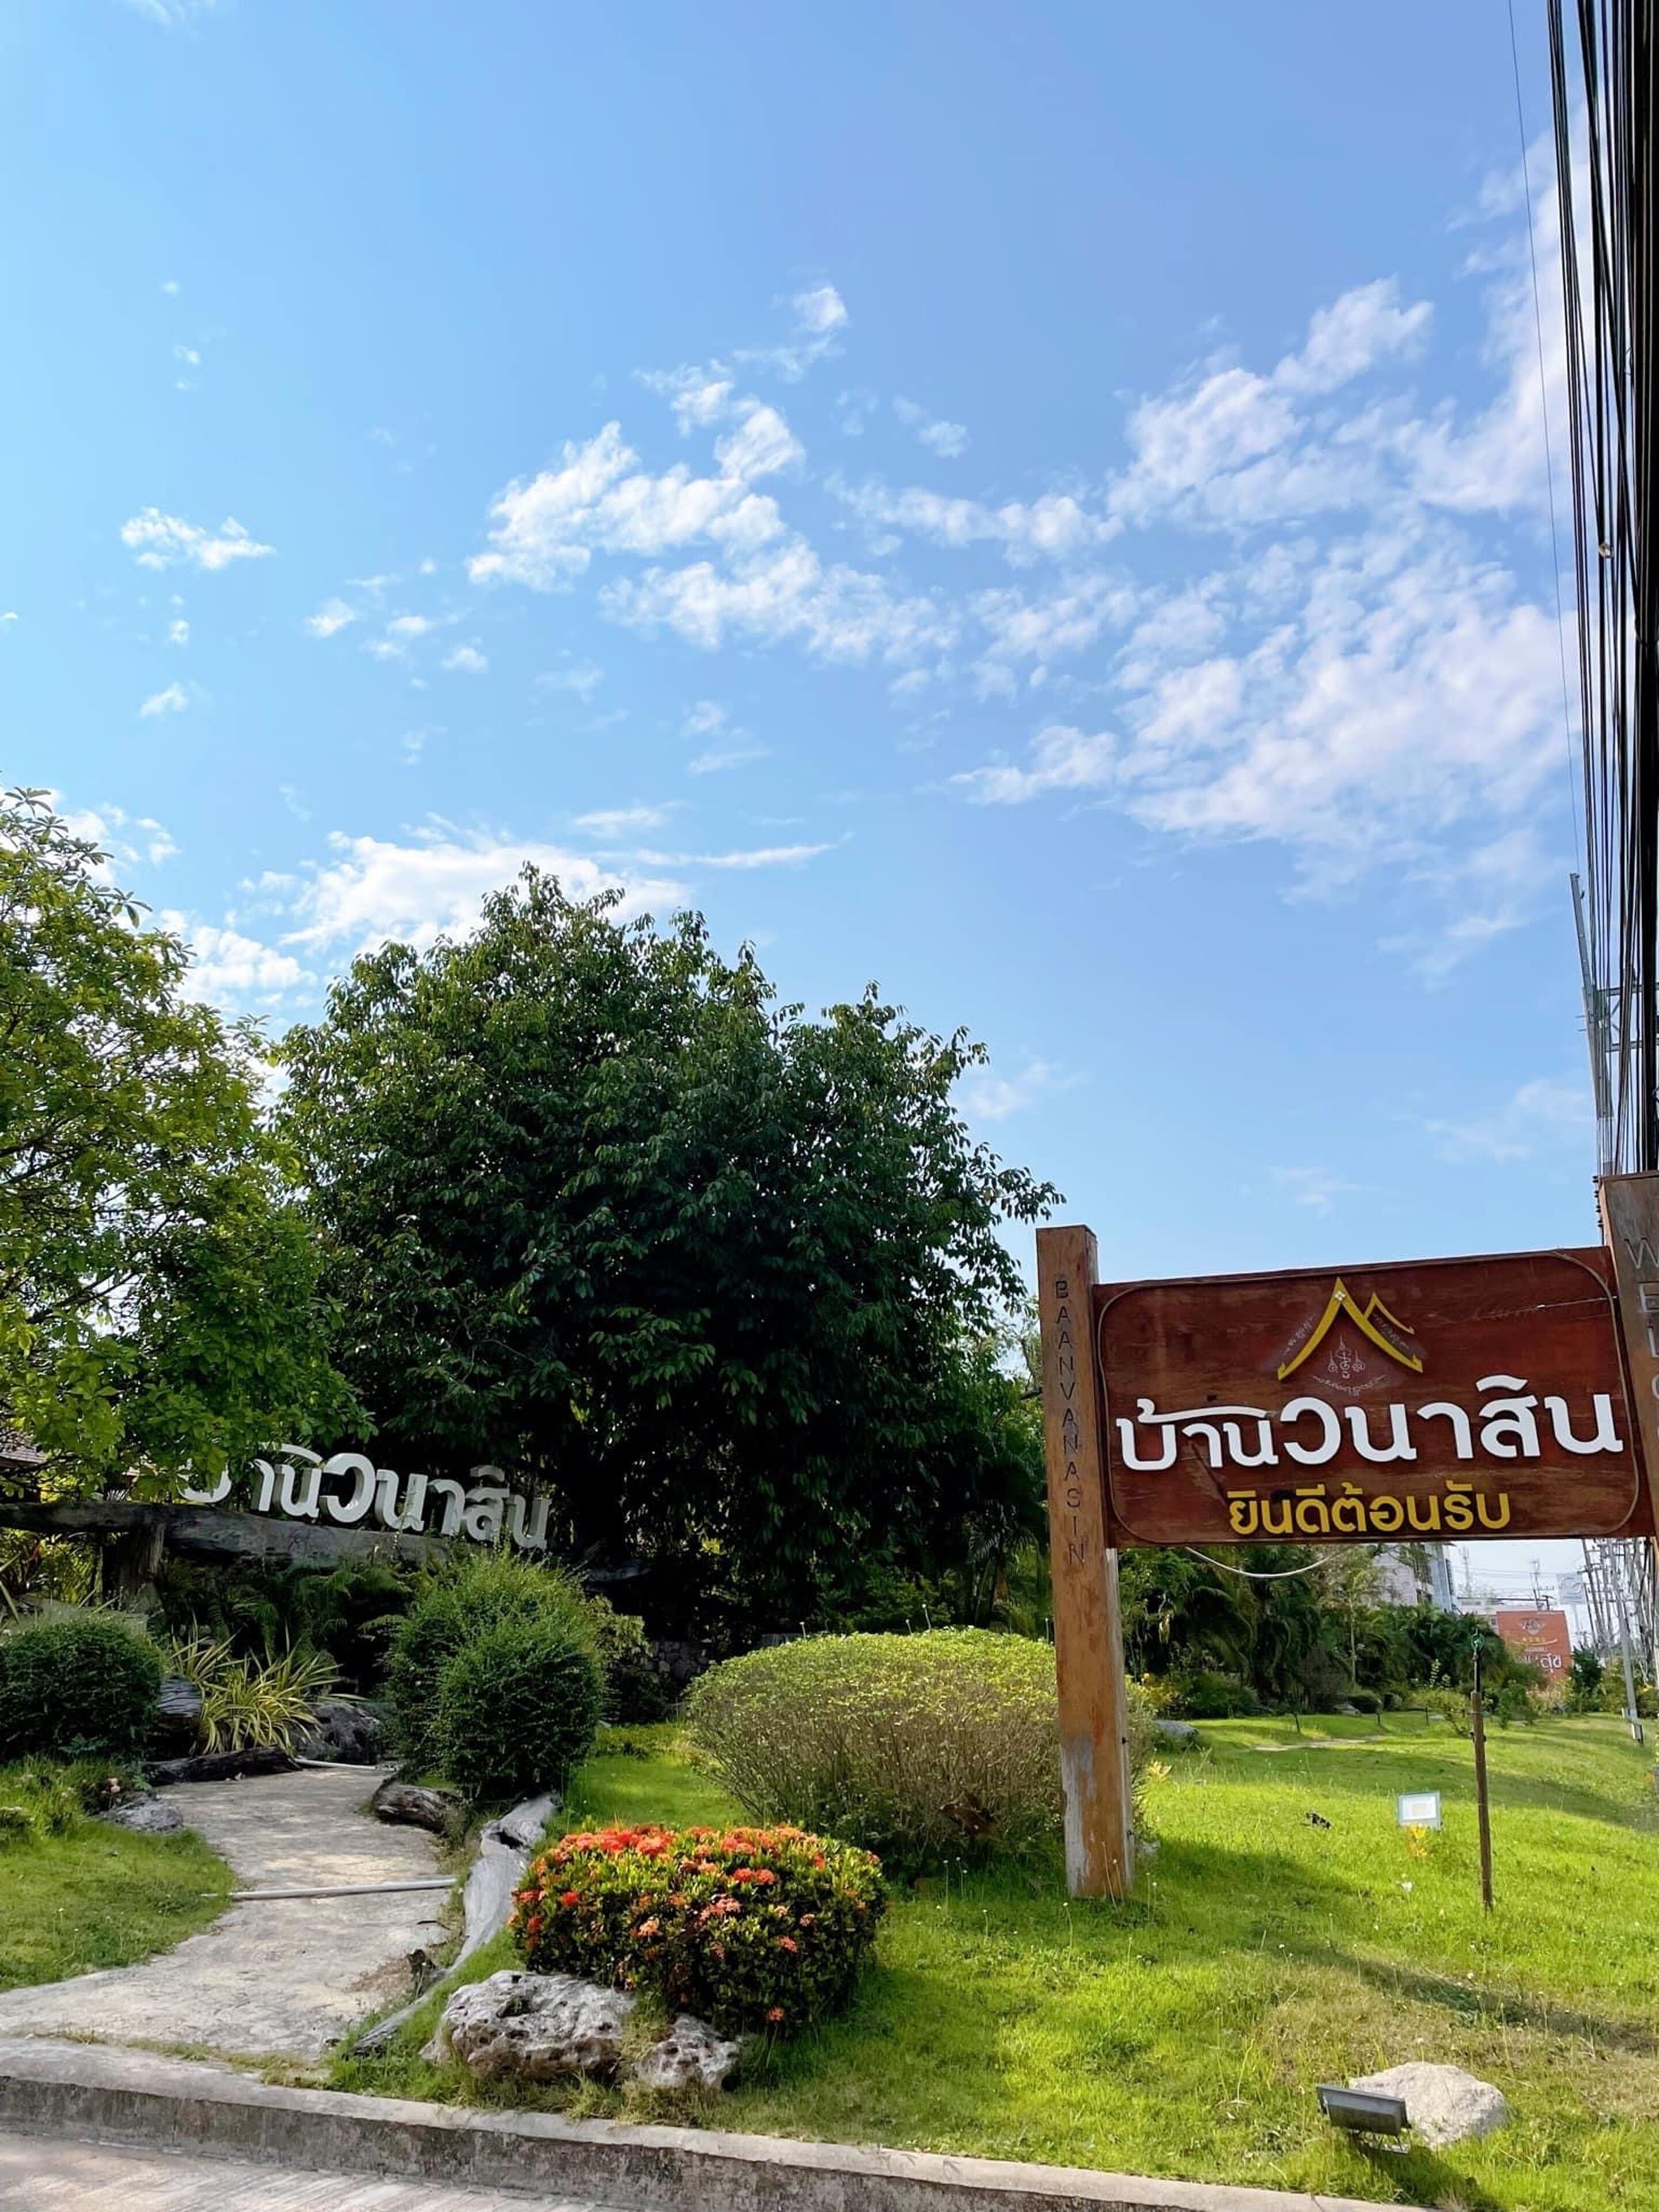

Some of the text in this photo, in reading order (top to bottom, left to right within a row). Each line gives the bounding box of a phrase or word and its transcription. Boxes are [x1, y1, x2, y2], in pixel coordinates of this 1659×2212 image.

[1624, 1237, 1659, 1435] WEL
[1055, 1280, 1085, 1564] BAANVANASIN
[1116, 1374, 1623, 1471] บ้านวนาสิน
[1226, 1480, 1510, 1535] ยินดีต้อนรับ
